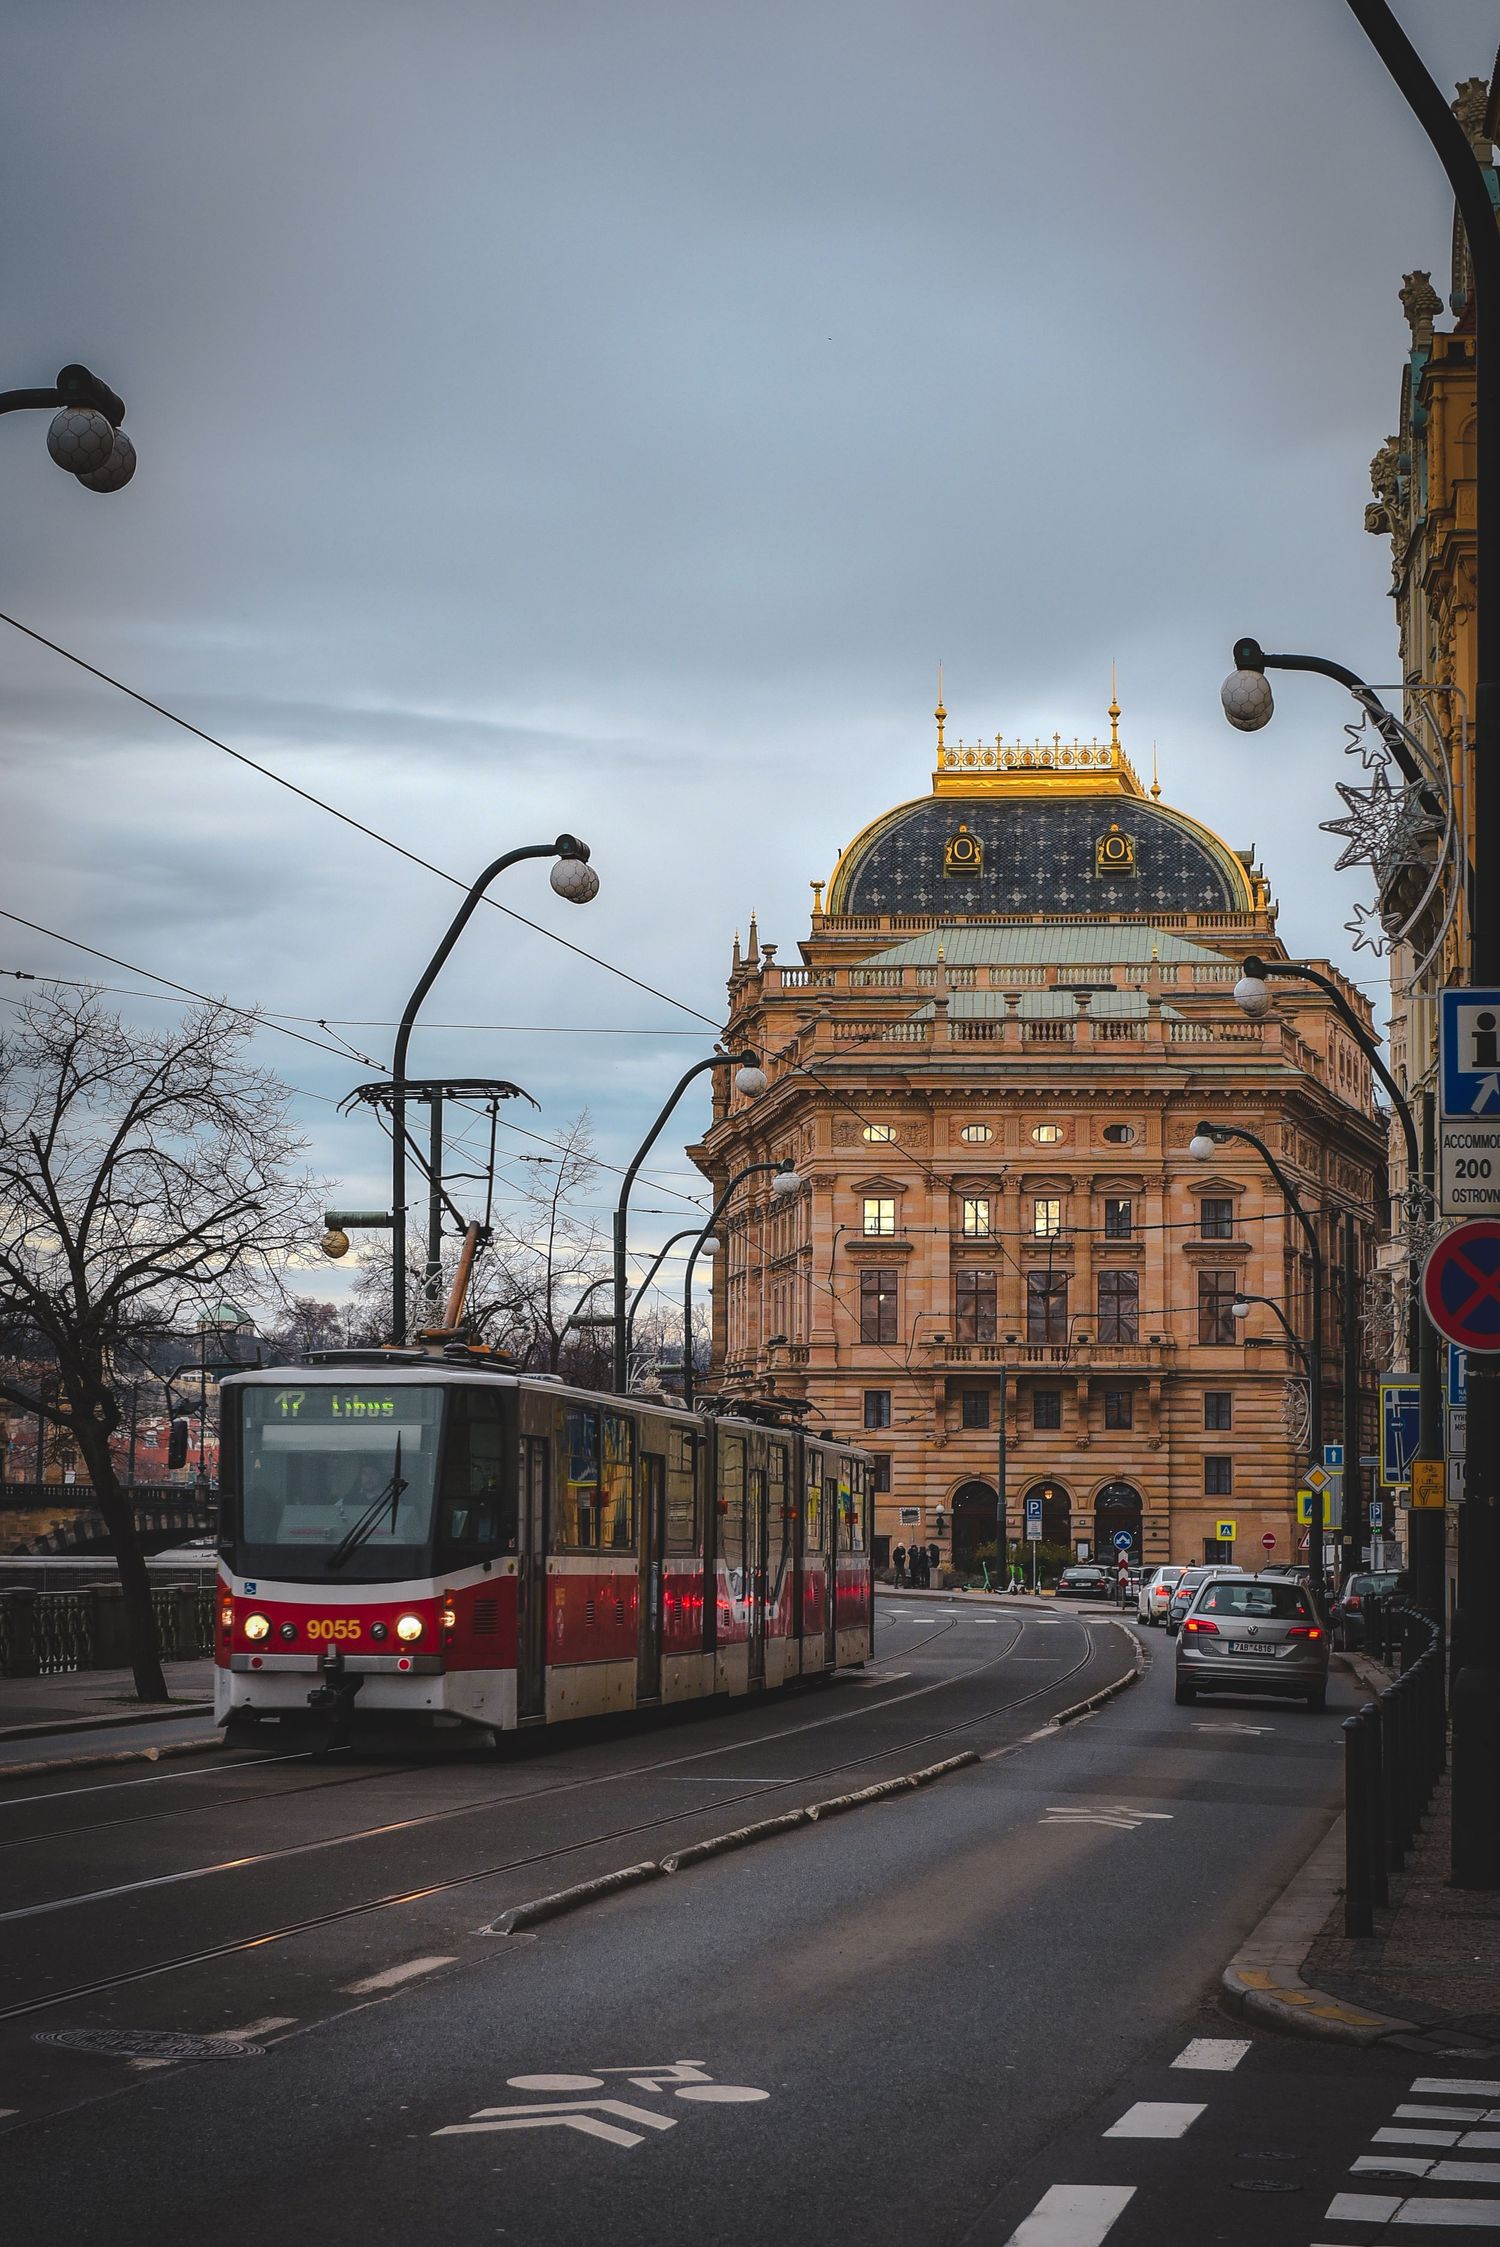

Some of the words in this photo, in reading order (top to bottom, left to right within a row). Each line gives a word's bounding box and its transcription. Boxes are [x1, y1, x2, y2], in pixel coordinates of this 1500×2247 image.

[1455, 1158, 1491, 1179] 200
[274, 1390, 305, 1417] 17
[331, 1393, 395, 1418] Libuš
[1030, 1502, 1039, 1514] P
[306, 1619, 362, 1640] 9055
